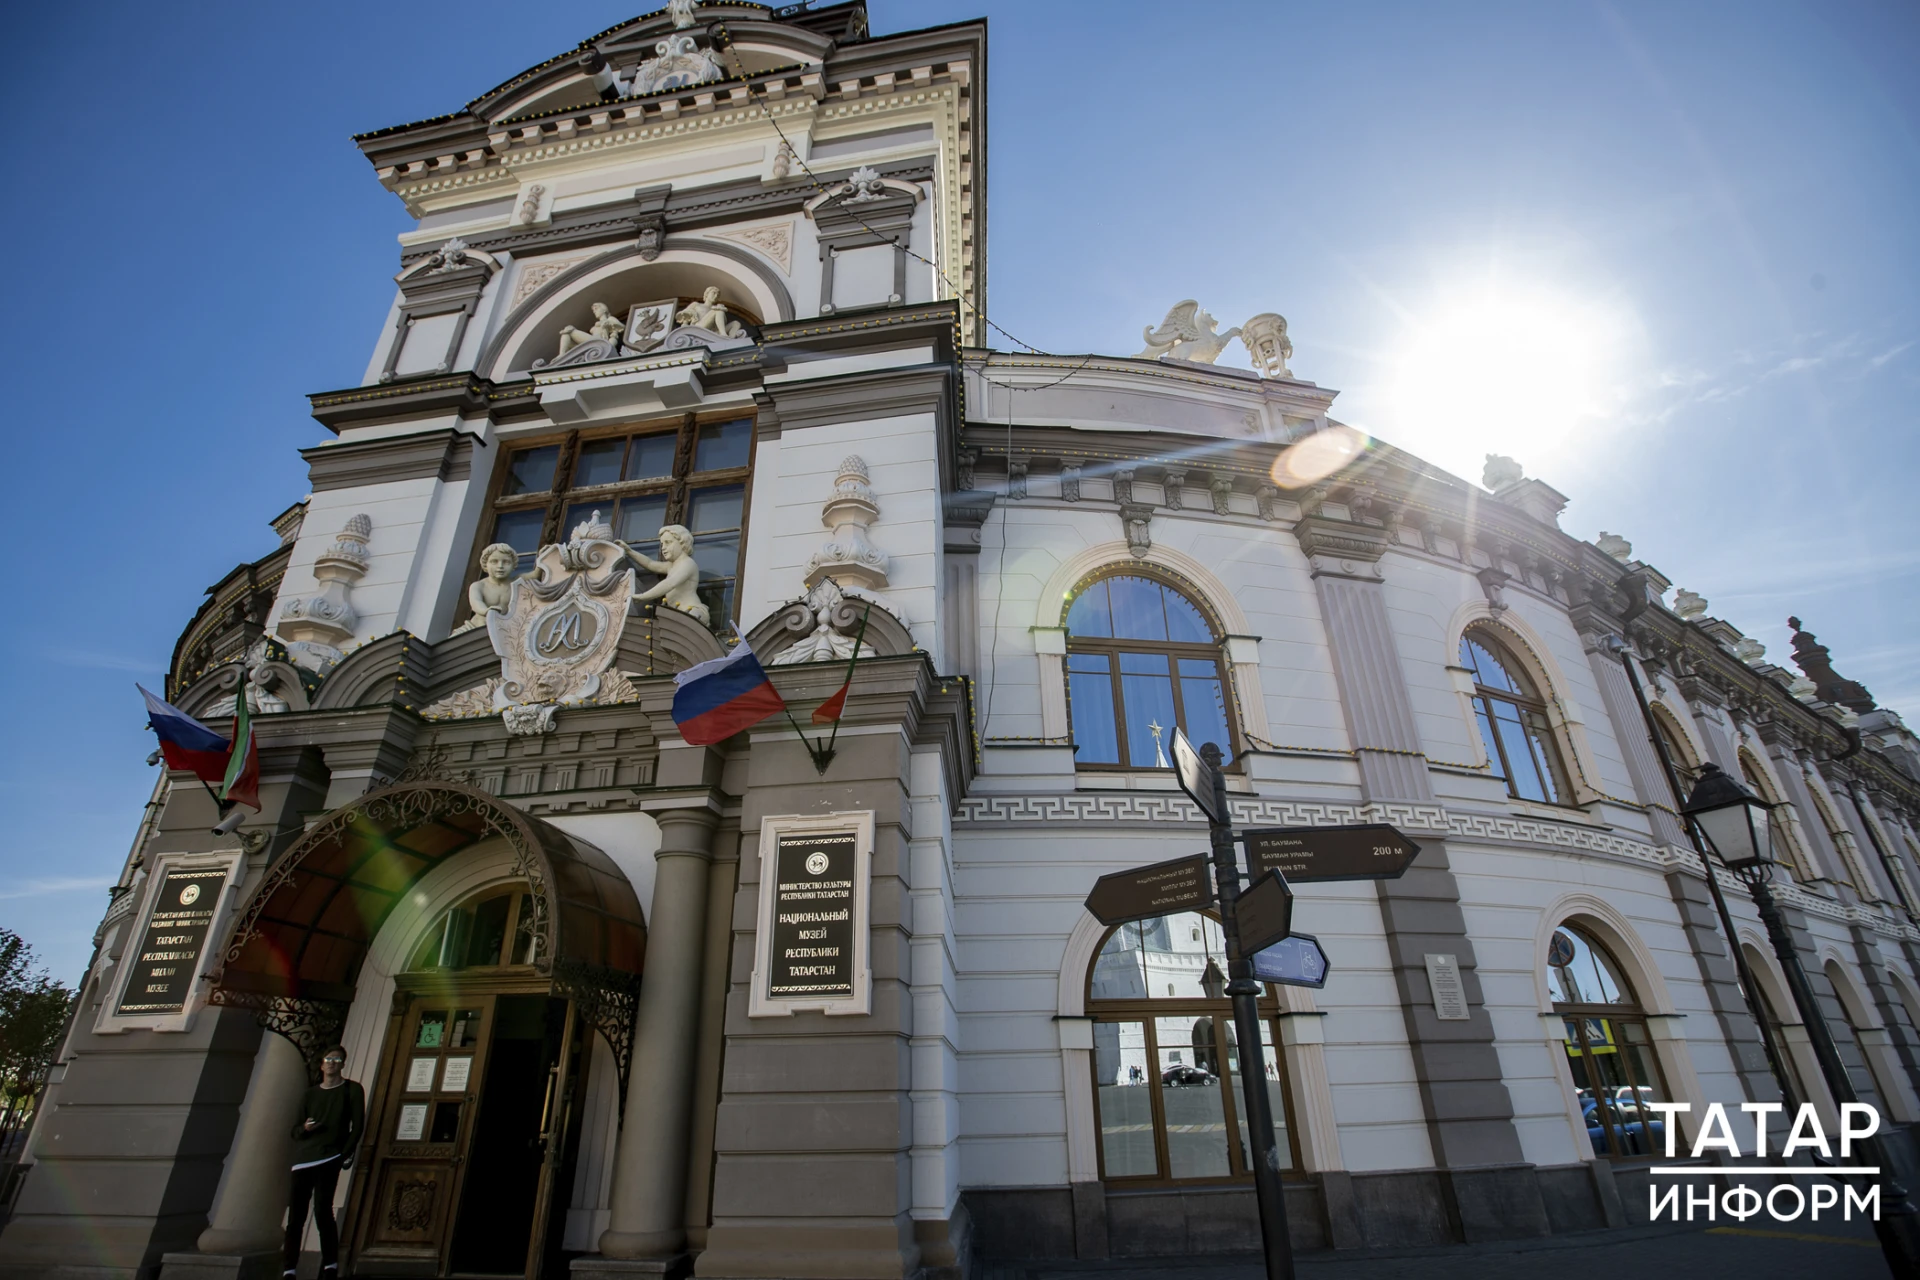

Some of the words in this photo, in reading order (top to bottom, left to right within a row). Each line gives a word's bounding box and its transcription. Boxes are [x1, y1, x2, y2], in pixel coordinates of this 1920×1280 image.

[1262, 852, 1289, 860] БАУМАН
[1373, 846, 1392, 856] 200
[779, 882, 823, 891] МИНИСТЕРСТВО
[823, 880, 852, 889] КУЛЬТУРЫ
[781, 892, 816, 900] РЕСПУБЛИКИ
[817, 890, 849, 899] ТАТАРСТАН
[1176, 891, 1198, 901] MUSEUM
[779, 908, 849, 924] НАЦИОНАЛЬНЫЙ
[799, 927, 827, 940] МУЗЕЙ
[156, 935, 193, 945] ТАТАРСТАН
[785, 946, 840, 958] РЕСПУБЛИКИ
[789, 965, 836, 976] ТАТАРСТАН
